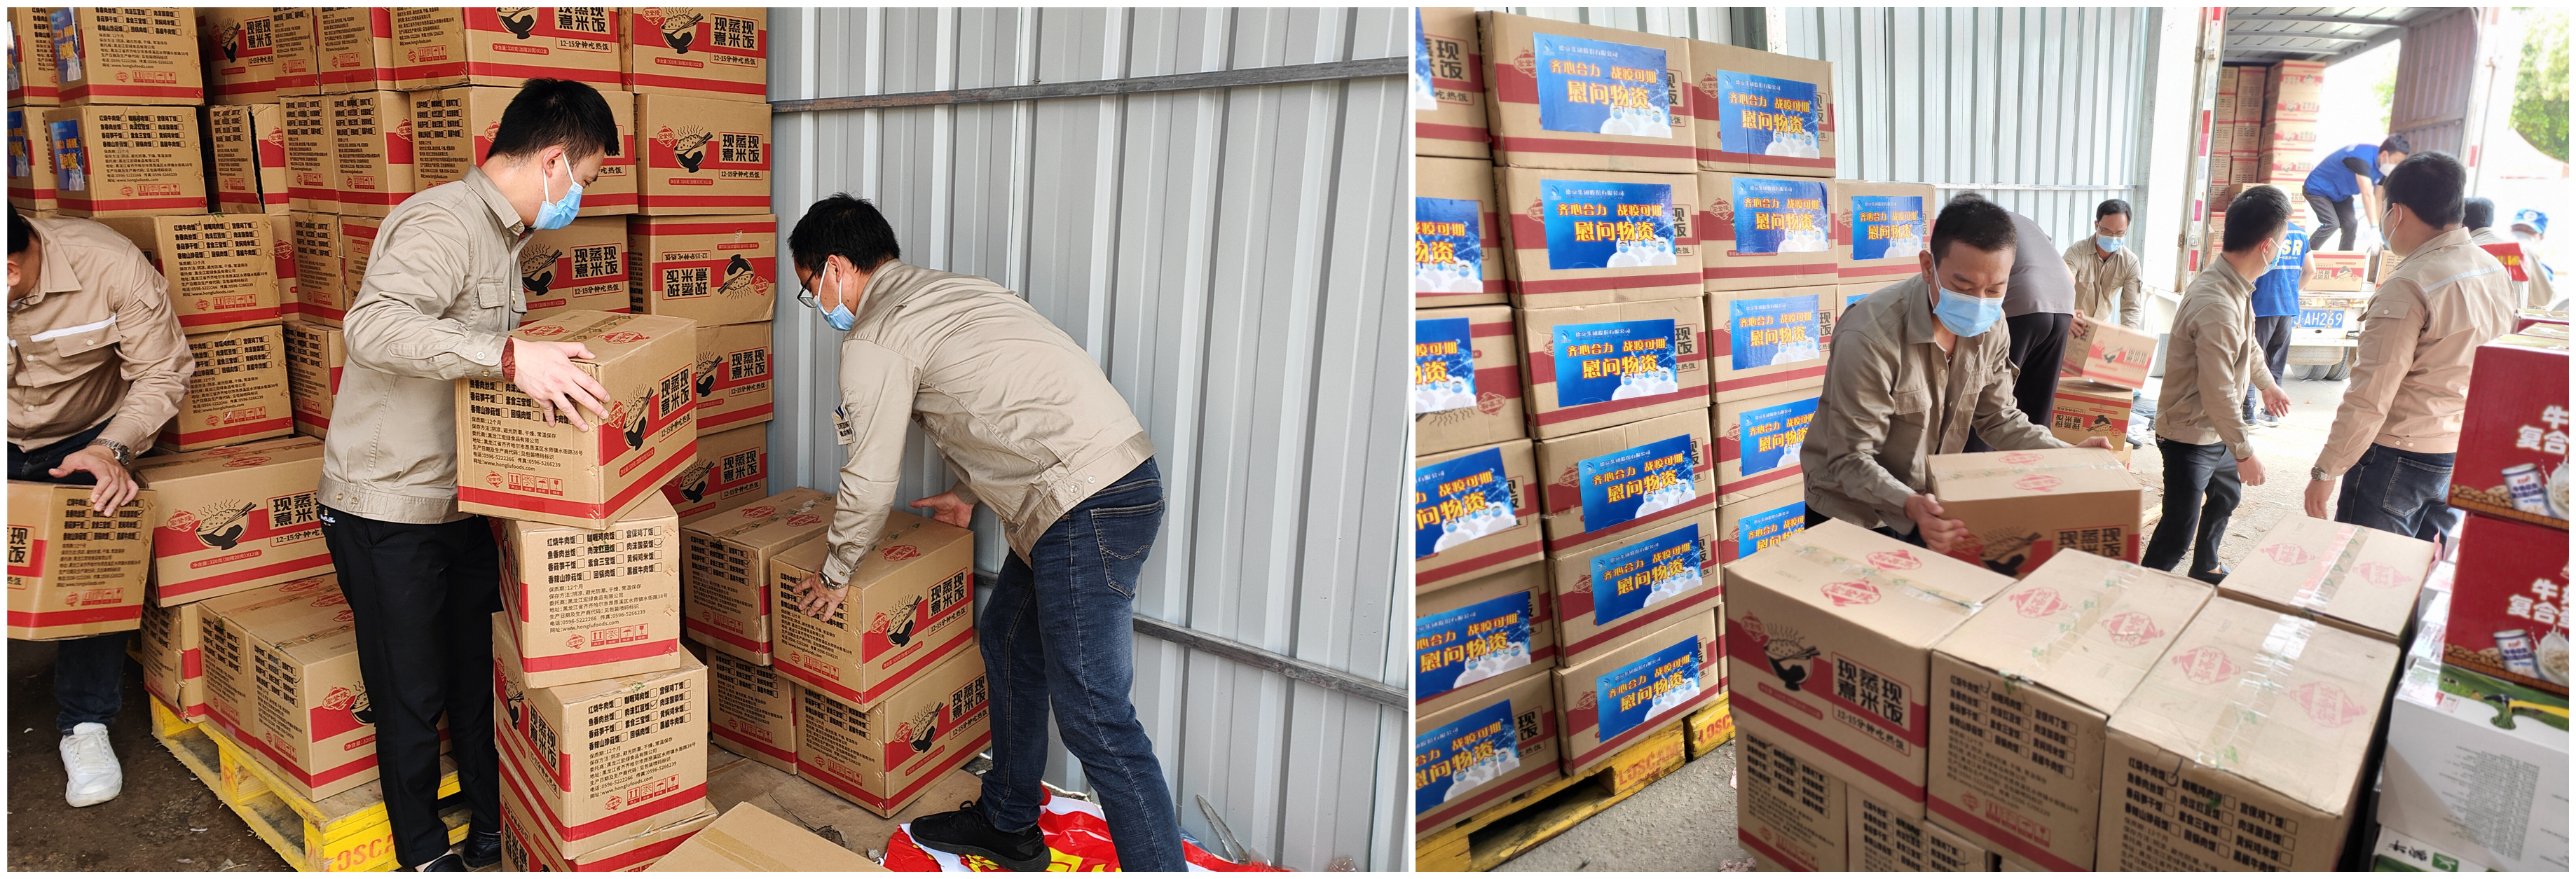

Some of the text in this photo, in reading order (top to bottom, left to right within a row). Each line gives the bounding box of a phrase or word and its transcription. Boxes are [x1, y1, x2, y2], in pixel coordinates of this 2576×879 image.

[247, 19, 270, 34] 现蒸现
[559, 15, 605, 32] 煮米饭
[714, 17, 754, 35] 现蒸现
[560, 40, 609, 50] 12-15分钟吃热饭
[714, 32, 755, 49] 煮米饭
[713, 55, 756, 65] 12-15分钟吃热饭
[1549, 59, 1657, 84] 齐心合力 战疫可期
[1567, 81, 1649, 109] 慰问物资
[1728, 92, 1810, 113] 齐心合力 战疫可期
[1741, 109, 1804, 134] 慰问物资
[722, 134, 759, 148] 现蒸现
[722, 148, 760, 162] 煮米饭
[1557, 202, 1663, 216] 齐心合力 战疫可期
[1743, 197, 1819, 209] 齐心合力 战疫可期
[1755, 212, 1814, 230] 慰问物资
[1860, 211, 1917, 222] 齐心合力 战疫可期
[1575, 221, 1656, 242] 慰问物资
[1868, 224, 1912, 240] 慰问物资
[575, 247, 616, 263] 现蒸现
[575, 261, 618, 278] 煮米饭
[666, 268, 707, 284] 煮米饭
[575, 284, 619, 295] 12-15分钟吃热饭
[668, 282, 707, 297] 现蒸现
[1739, 312, 1811, 328] 齐心合力 战疫可期
[1751, 326, 1805, 347] 慰问物资
[732, 349, 764, 366] 现蒸现
[1567, 338, 1666, 357] 齐心合力 战疫可期
[732, 362, 765, 380] 煮米饭
[1582, 354, 1659, 380] 慰问物资
[470, 380, 495, 391] 鱼香肉丝饭
[662, 368, 689, 399] 现蒸现
[731, 382, 765, 394] 12-15分钟吃热饭
[471, 392, 531, 408] 香菇笋干饭 素食三宝饭
[661, 387, 689, 417] 煮米饭
[471, 405, 532, 420] 香辣山珍菇饭 回锅肉饭
[661, 413, 690, 438] 12-15分钟吃热饭
[1749, 421, 1781, 436] 齐心合力
[724, 450, 756, 470] 现蒸现
[1592, 452, 1683, 486] 齐心合力 战疫可期
[724, 463, 757, 483] 煮米饭
[1439, 470, 1493, 497] 战疫可期
[724, 482, 758, 497] 12-15分钟吃热饭
[1608, 469, 1678, 504] 慰问物资
[547, 528, 653, 546] 红烧牛肉饭 咖喱鸡肉饭 宫保鸡丁饭
[1748, 523, 1777, 541] 齐心合力
[547, 540, 653, 559] 鱼香肉丝饭 肉沫豇豆饭 肉沫酸菜饭
[548, 552, 654, 572] 香菇笋干饭 素食三宝饭 黄焖鸡米饭
[1603, 541, 1690, 582] 齐心合力 战疫可期
[548, 565, 654, 583] 香辣山珍菇饭 回锅肉饭 黑椒牛肉饭
[1617, 558, 1685, 596] 慰问物资
[931, 572, 964, 602] 现蒸现
[931, 586, 964, 616] 煮米饭
[931, 608, 966, 632] 12-15分钟吃热饭
[1467, 613, 1518, 637] 战疫可期
[1420, 632, 1509, 673] 慰问物资
[1608, 654, 1690, 700] 齐心合力 战疫可期
[1837, 658, 1902, 704] 现蒸现
[588, 681, 683, 715] 红烧牛肉饭 咖喱鸡肉饭 宫保鸡丁饭
[952, 675, 985, 707] 现蒸现
[1620, 670, 1683, 712] 慰问物资
[588, 693, 684, 727] 鱼香肉丝饭 肉沫豇豆饭 肉沫酸菜饭
[952, 688, 985, 721] 煮米饭
[1837, 678, 1903, 726] 煮米饭
[530, 704, 556, 752] 现蒸现
[588, 705, 684, 739] 香菇笋干饭 素食三宝饭 黄焖鸡米饭
[953, 708, 987, 736] 12-15分钟吃热饭
[1699, 713, 1734, 744] LOSC
[1837, 709, 1905, 752] 12-15分钟吃热饭
[589, 717, 684, 751] 香辣山珍菇饭 回锅肉饭 黑椒牛肉饭
[1452, 721, 1502, 751] 战疫可期
[530, 724, 556, 772] 煮米饭
[1619, 740, 1680, 785] LOSCAM
